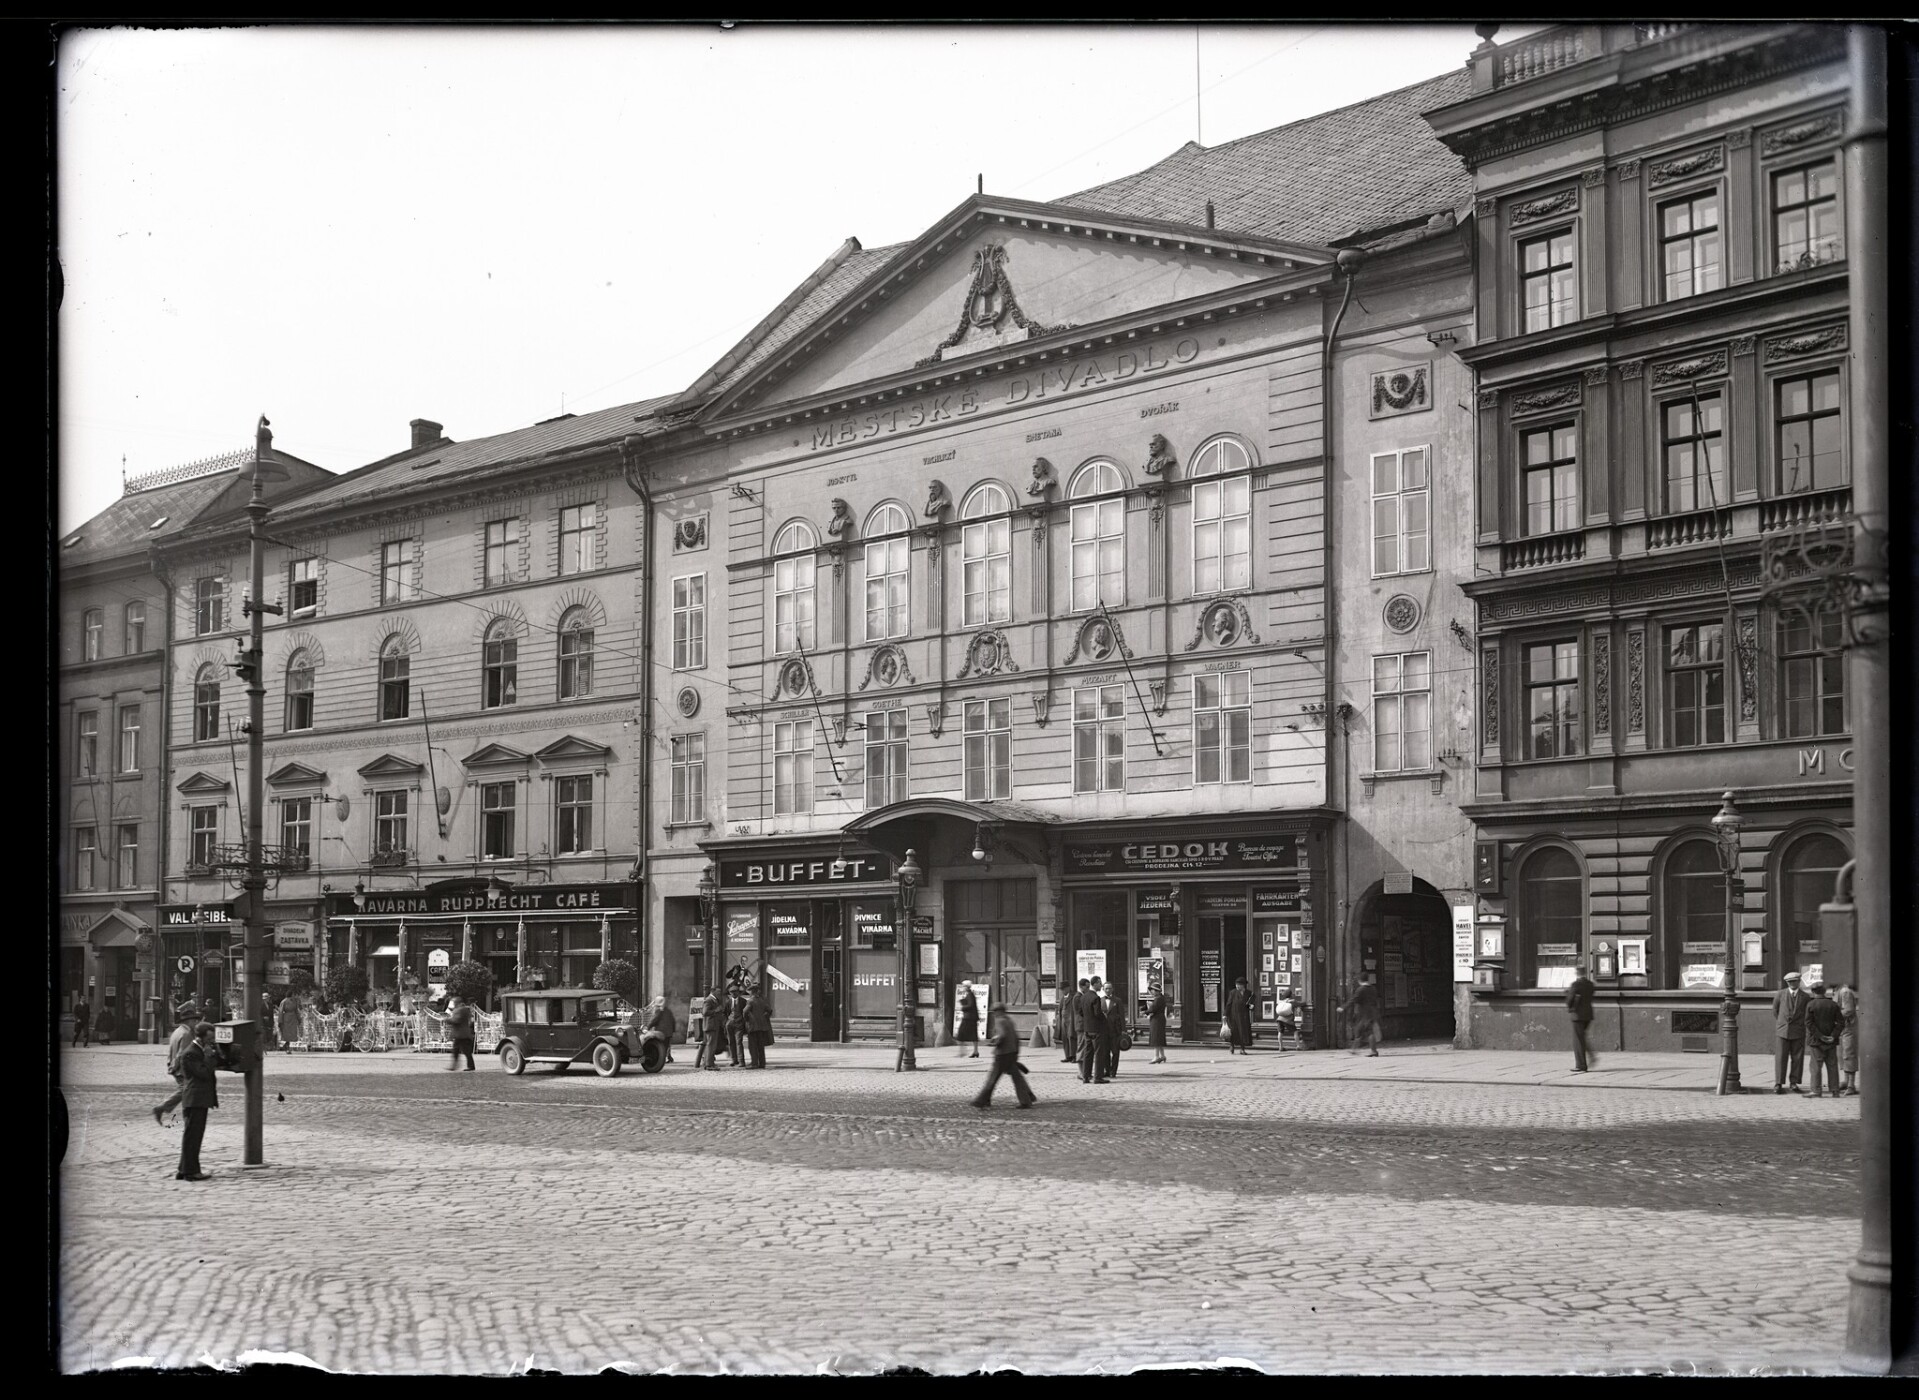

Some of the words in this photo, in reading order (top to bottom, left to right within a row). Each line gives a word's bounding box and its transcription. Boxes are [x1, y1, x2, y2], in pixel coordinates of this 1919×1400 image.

[1006, 337, 1199, 405] DIVADLO
[1025, 427, 1062, 443] SMETANA
[1203, 660, 1241, 672] WAGNER
[1081, 674, 1117, 685] MOZART
[872, 698, 902, 709] GOETHE
[780, 709, 810, 720] SCHILLER
[1121, 841, 1229, 860] ČEDOK
[441, 894, 542, 911] RUPPRECHT
[556, 890, 601, 908] CAFÉ
[771, 914, 797, 924] JÍDELNA
[854, 913, 882, 922] PIVNICE
[777, 926, 808, 935] KAVÁRNA
[861, 924, 893, 933] VINÁRNA
[853, 973, 897, 987] BUFFET
